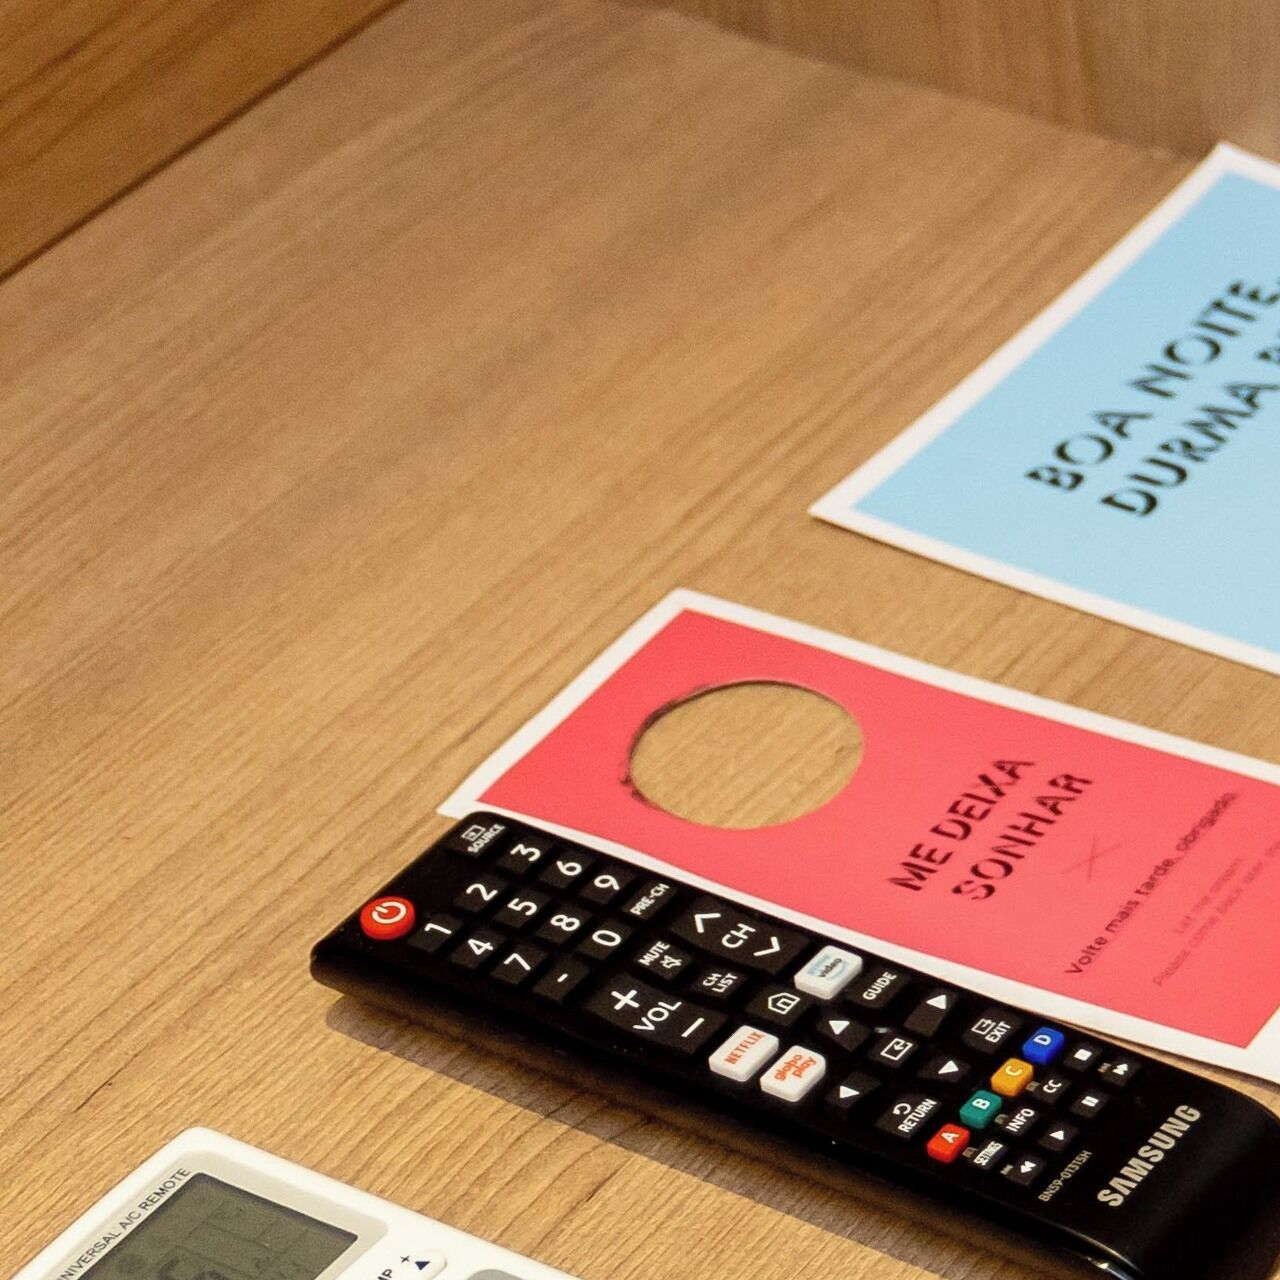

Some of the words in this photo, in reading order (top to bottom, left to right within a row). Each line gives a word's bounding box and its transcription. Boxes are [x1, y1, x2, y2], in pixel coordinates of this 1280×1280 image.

[1023, 407, 1151, 491] BOA
[887, 843, 954, 891] ME
[928, 758, 1036, 841] DEIXA
[467, 824, 505, 853] SOURCE
[949, 772, 1094, 901] SONHAR
[510, 844, 541, 861] 3
[556, 861, 582, 876] 6
[466, 883, 498, 901] 2
[594, 875, 620, 890] 9
[507, 898, 537, 915] 5
[630, 883, 670, 915] PRE-CH
[424, 923, 451, 935] 1
[550, 914, 580, 931] 8
[592, 930, 621, 946] 0
[721, 923, 756, 948] CH
[1064, 936, 1109, 974] Volte
[1103, 899, 1141, 933] mais
[467, 939, 493, 955] 4
[638, 941, 670, 965] MUTE
[504, 953, 531, 971] 7
[817, 958, 843, 978] video
[702, 973, 722, 986] CH
[712, 973, 737, 992] LIST
[862, 971, 897, 1000] GUIDE
[632, 1000, 682, 1031] VOL
[985, 1021, 1011, 1043] EXIT
[1033, 1035, 1051, 1045] D
[724, 1031, 765, 1064] NETFLIX
[773, 1054, 803, 1081] globo
[791, 1056, 817, 1078] play
[1005, 1066, 1022, 1076] C
[1043, 1079, 1062, 1093] CC
[972, 1098, 990, 1109] B
[898, 1098, 937, 1132] RETURN
[1006, 1108, 1035, 1132] INFO
[941, 1133, 959, 1143] A
[973, 1141, 1003, 1166] SETTINGS
[1096, 1104, 1201, 1207] SAMSUNG
[118, 1211, 142, 1230] A/C
[138, 1168, 191, 1211] REMOTE
